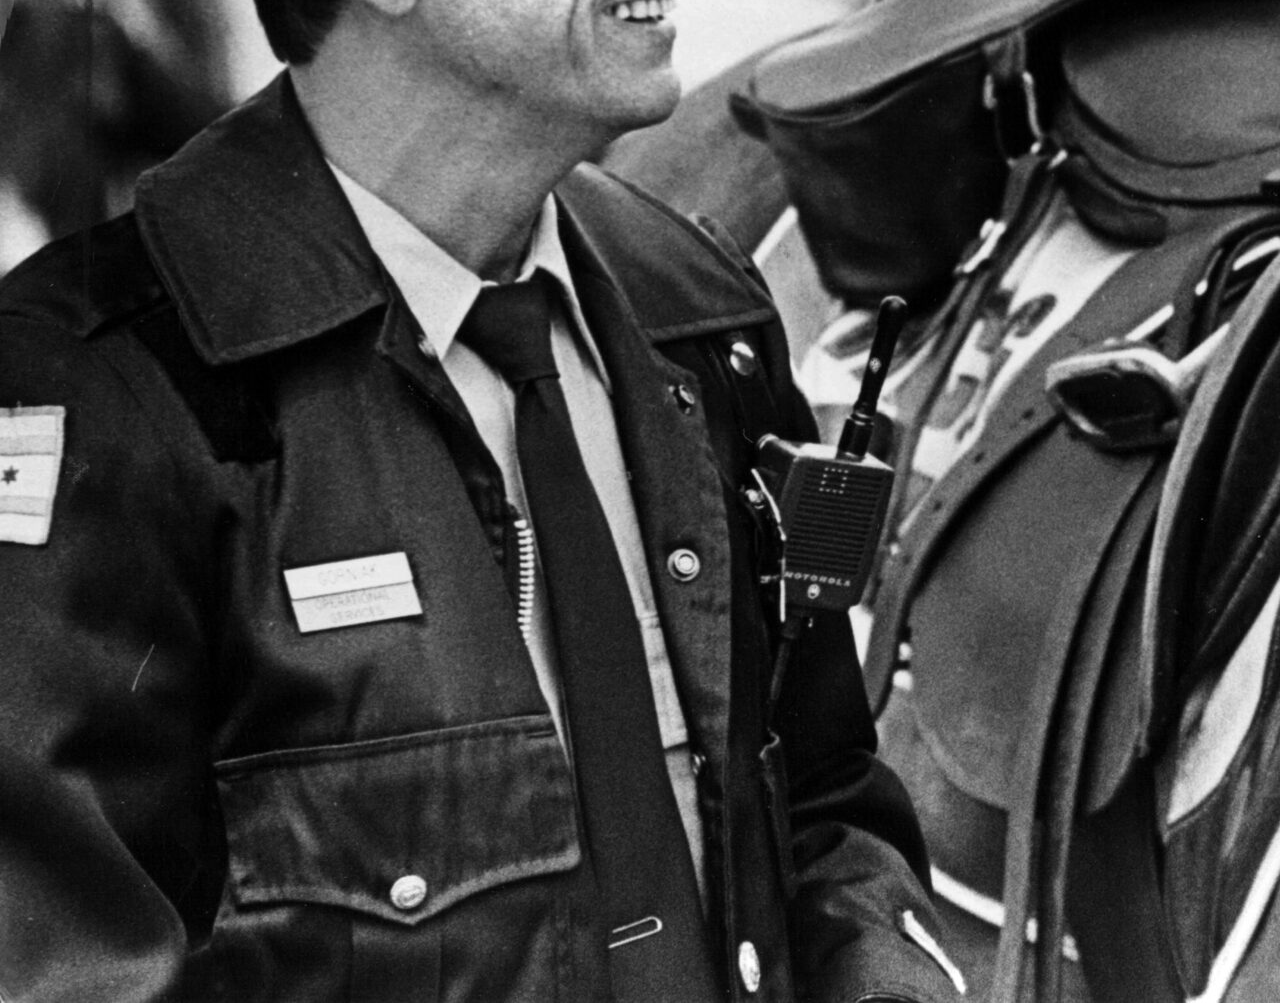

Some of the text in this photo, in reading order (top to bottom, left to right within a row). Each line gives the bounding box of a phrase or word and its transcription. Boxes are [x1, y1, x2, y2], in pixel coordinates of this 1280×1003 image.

[784, 571, 851, 586] MOTOROLA
[314, 588, 392, 612] OPERATIONAL
[330, 606, 385, 624] SERVICES
